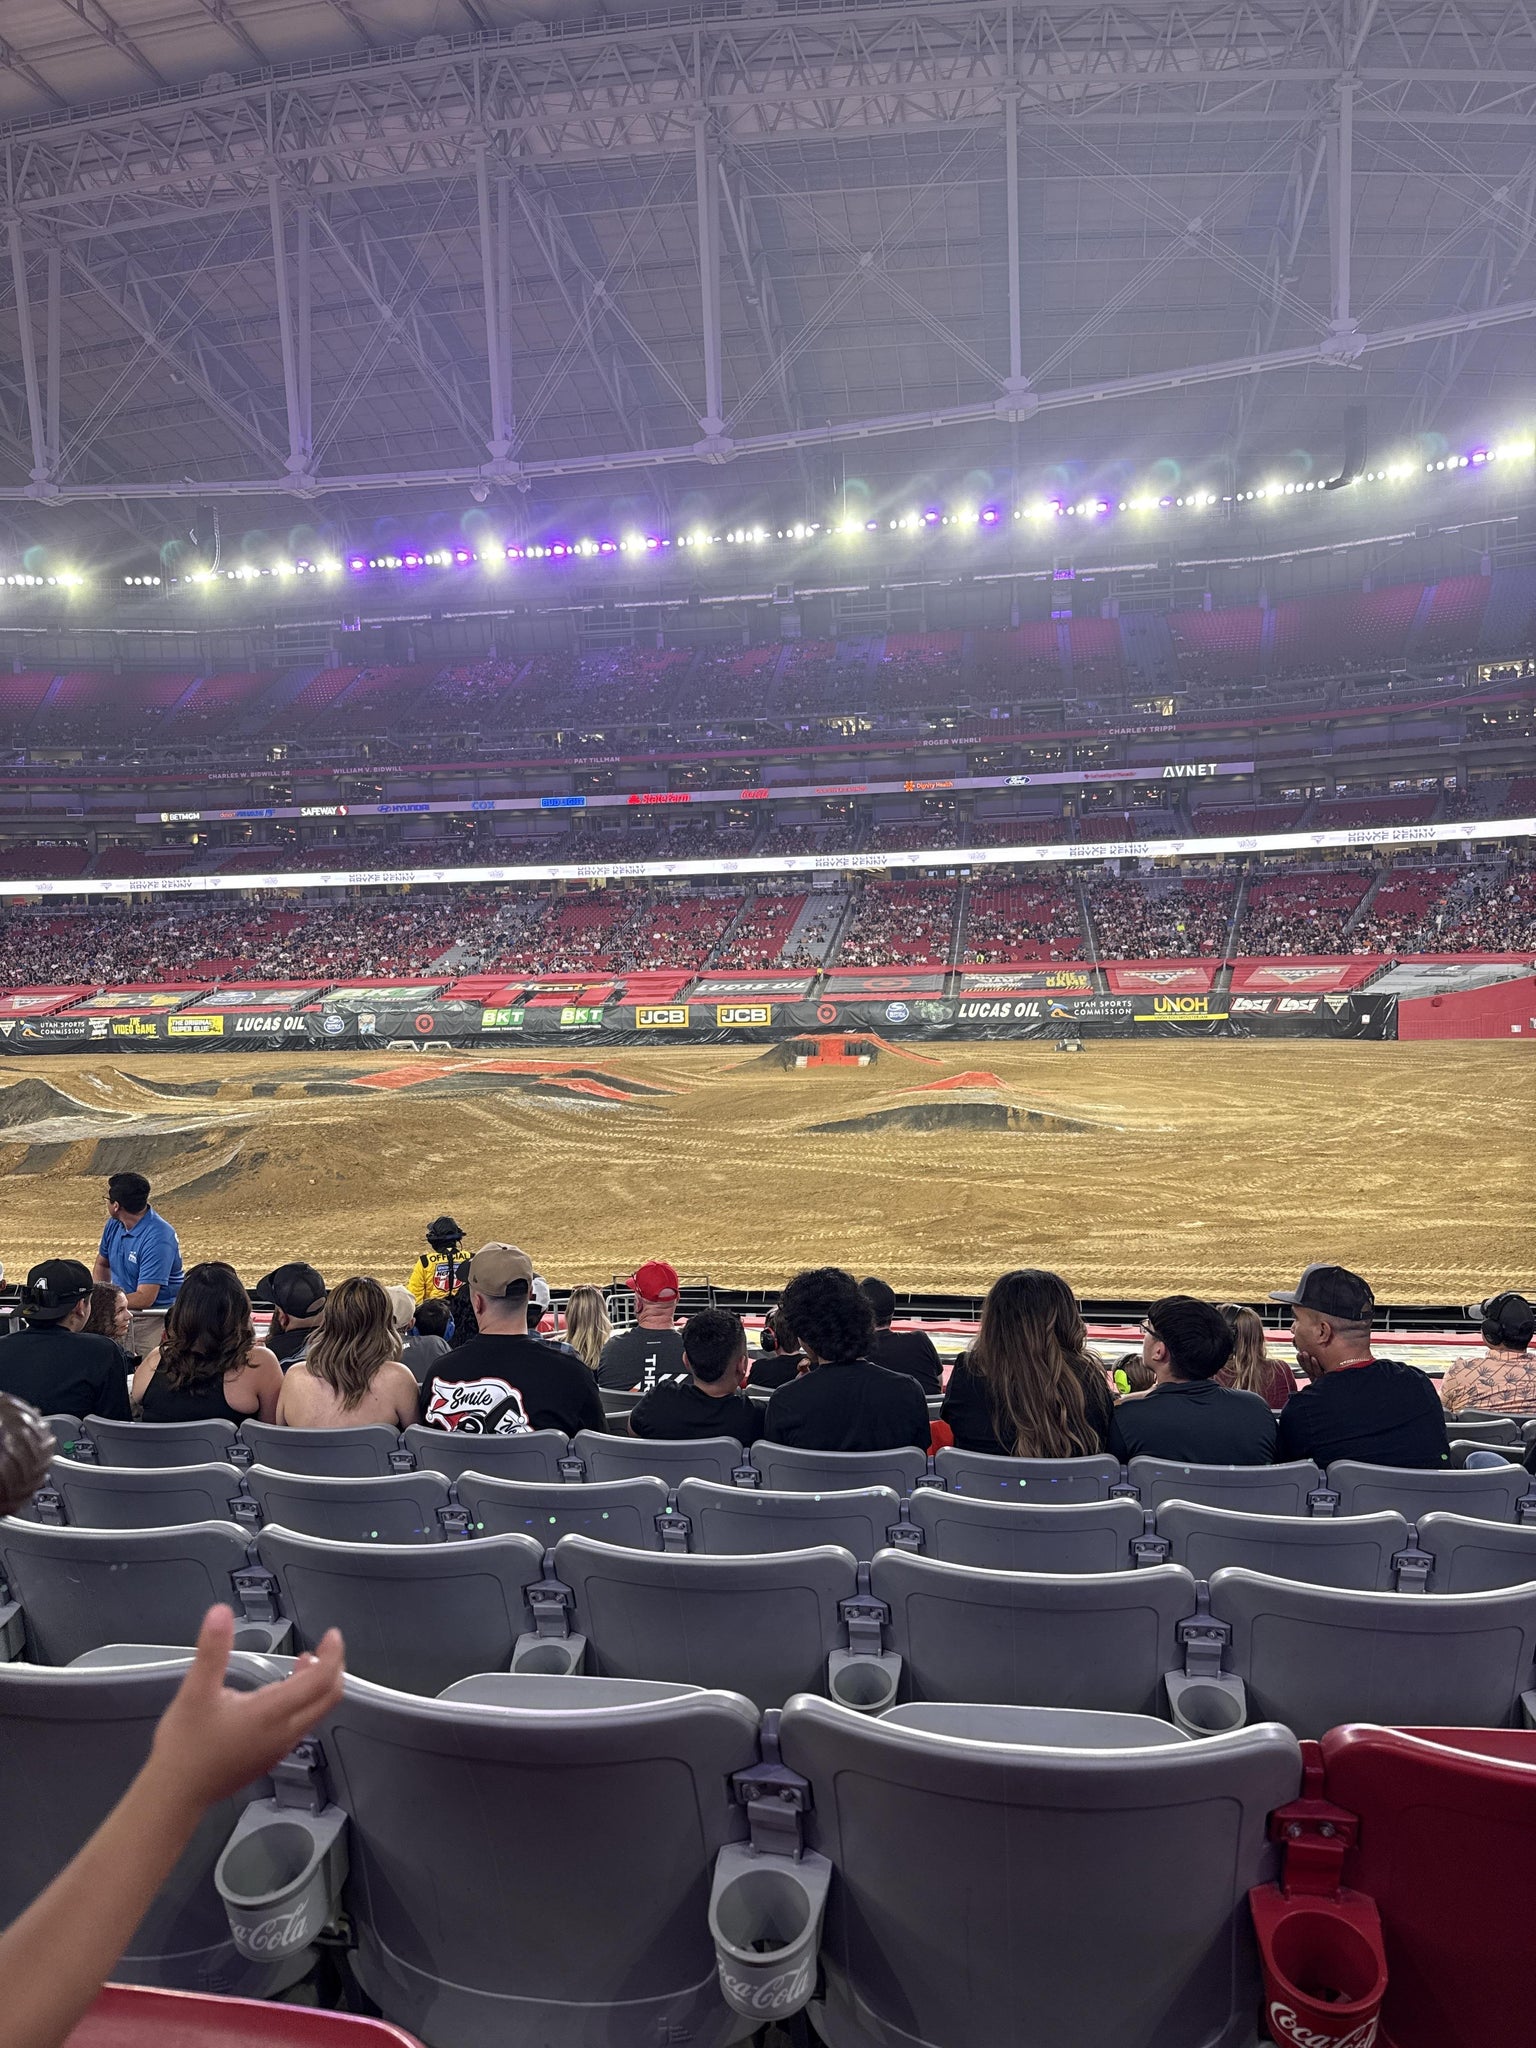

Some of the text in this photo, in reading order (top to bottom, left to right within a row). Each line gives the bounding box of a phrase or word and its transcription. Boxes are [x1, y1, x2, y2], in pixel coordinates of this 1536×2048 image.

[1109, 727, 1147, 735] CHARLEY
[1163, 764, 1217, 777] AVNET
[301, 806, 337, 816] SAFEWAY
[392, 804, 430, 812] HYUNDAI
[471, 801, 495, 809] COX
[169, 812, 200, 820] BETMGM
[1154, 995, 1208, 1012] UNOH
[561, 1009, 603, 1024] BKT
[640, 1009, 685, 1024] JCB
[722, 1008, 767, 1022] JCB
[958, 1003, 1011, 1018] LUCAS
[130, 1017, 141, 1025] THE
[235, 1017, 282, 1031] LUCAS
[482, 1010, 524, 1025] BKT
[112, 1024, 135, 1035] VIDEO
[135, 1023, 157, 1034] GAME
[450, 1387, 493, 1410] Smile
